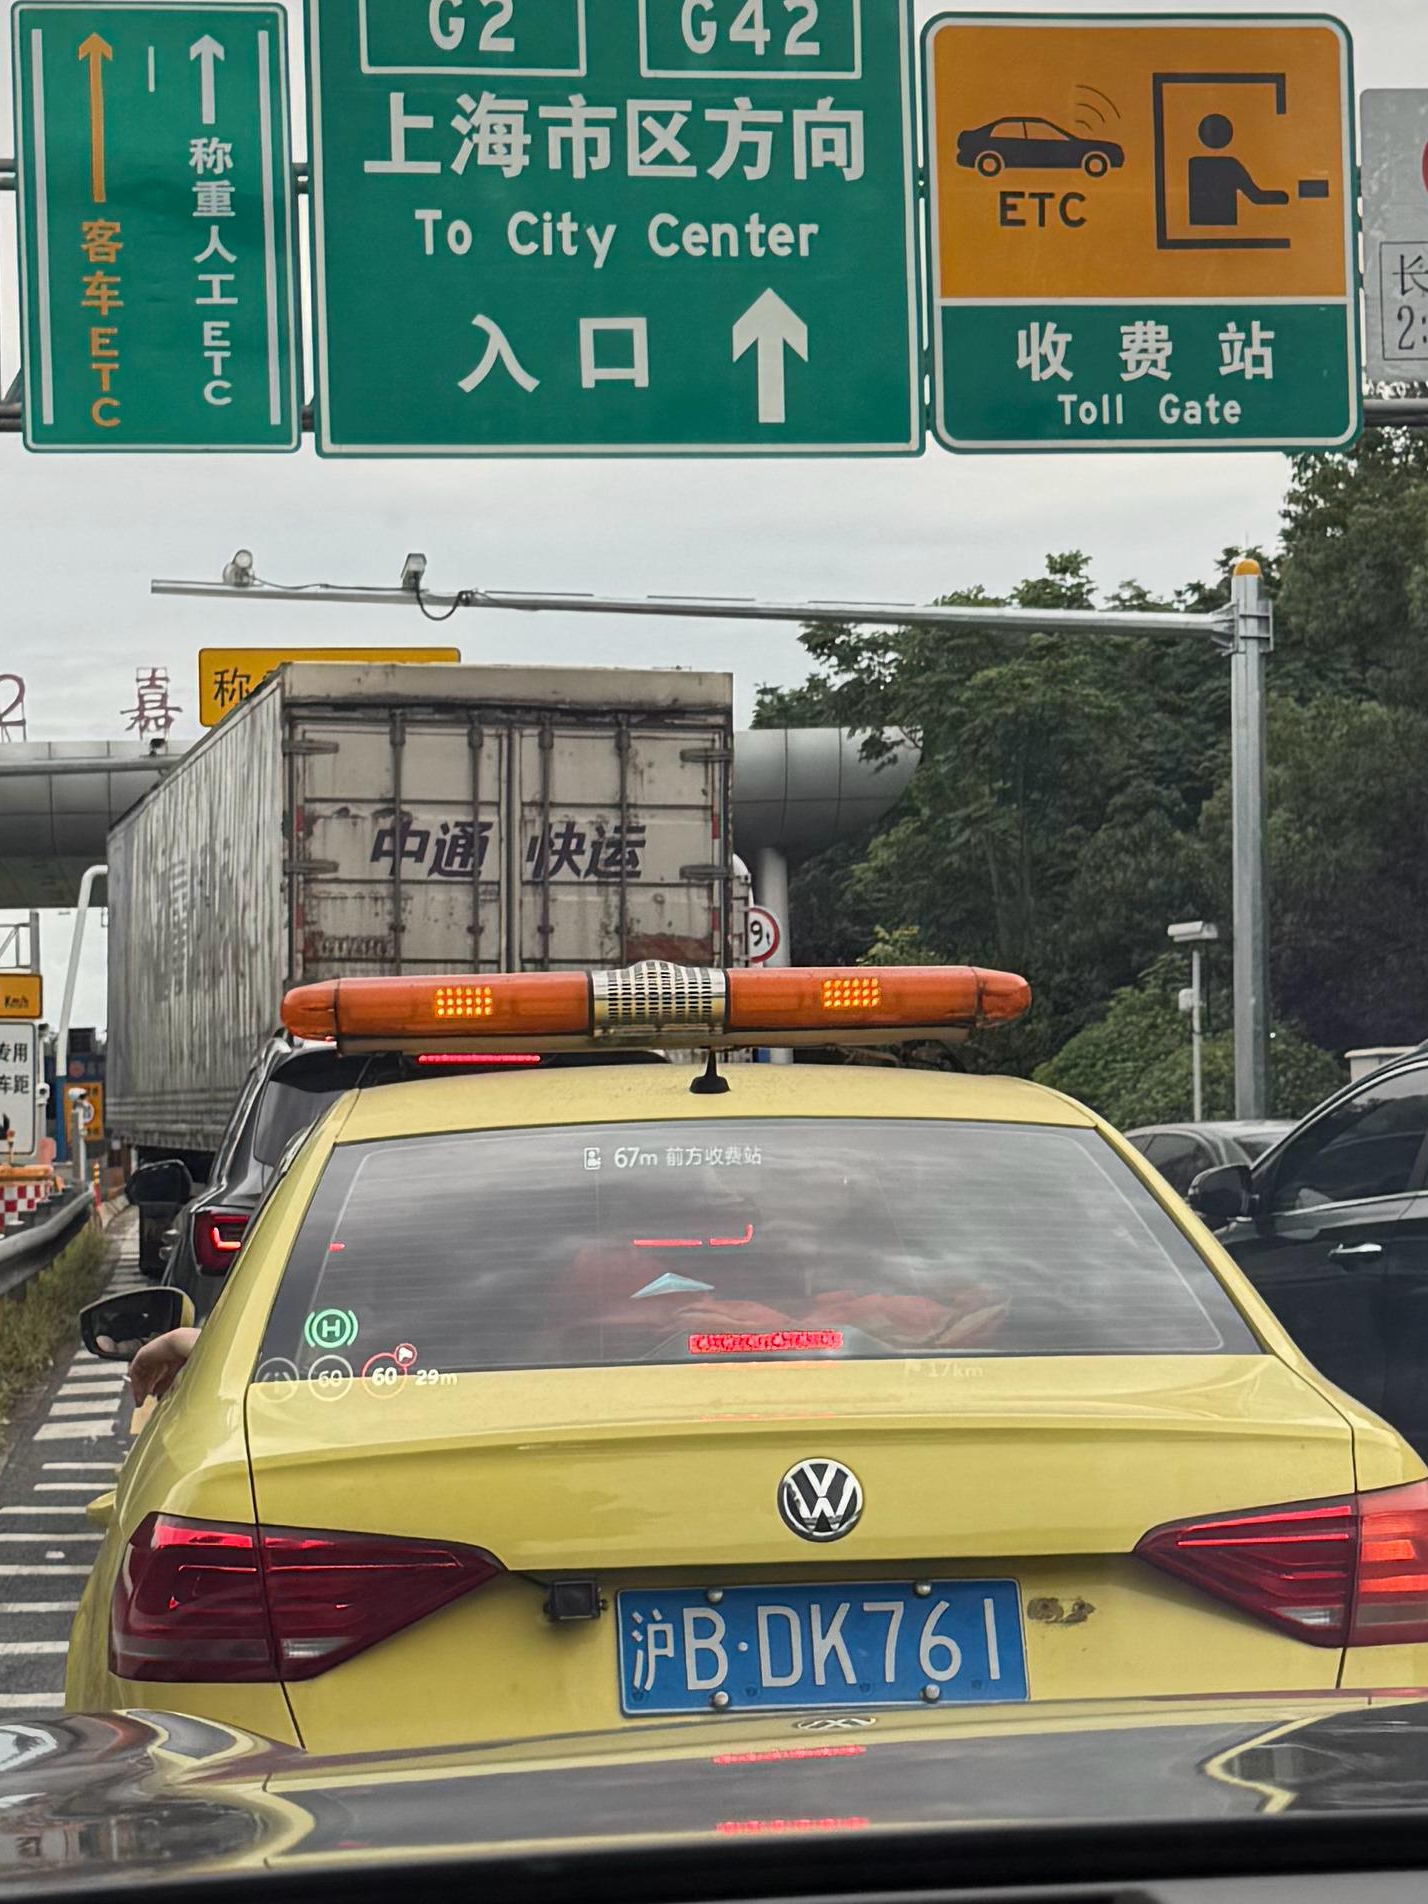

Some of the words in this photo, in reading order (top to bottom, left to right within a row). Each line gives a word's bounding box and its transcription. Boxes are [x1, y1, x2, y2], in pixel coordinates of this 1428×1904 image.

[364, 91, 865, 182] 上海市区方向
[999, 190, 1087, 228] ETC
[415, 209, 472, 256] To
[507, 210, 617, 269] City
[648, 212, 819, 258] Center
[457, 313, 649, 393] 入口
[1016, 320, 1275, 382] 收费站
[1058, 394, 1124, 426] Toll
[1159, 394, 1242, 426] Gate
[614, 1147, 658, 1168] 67m
[666, 1146, 762, 1167] 前方收费站
[318, 1369, 342, 1388] 60
[371, 1367, 398, 1386] 60
[414, 1368, 458, 1386] 29m
